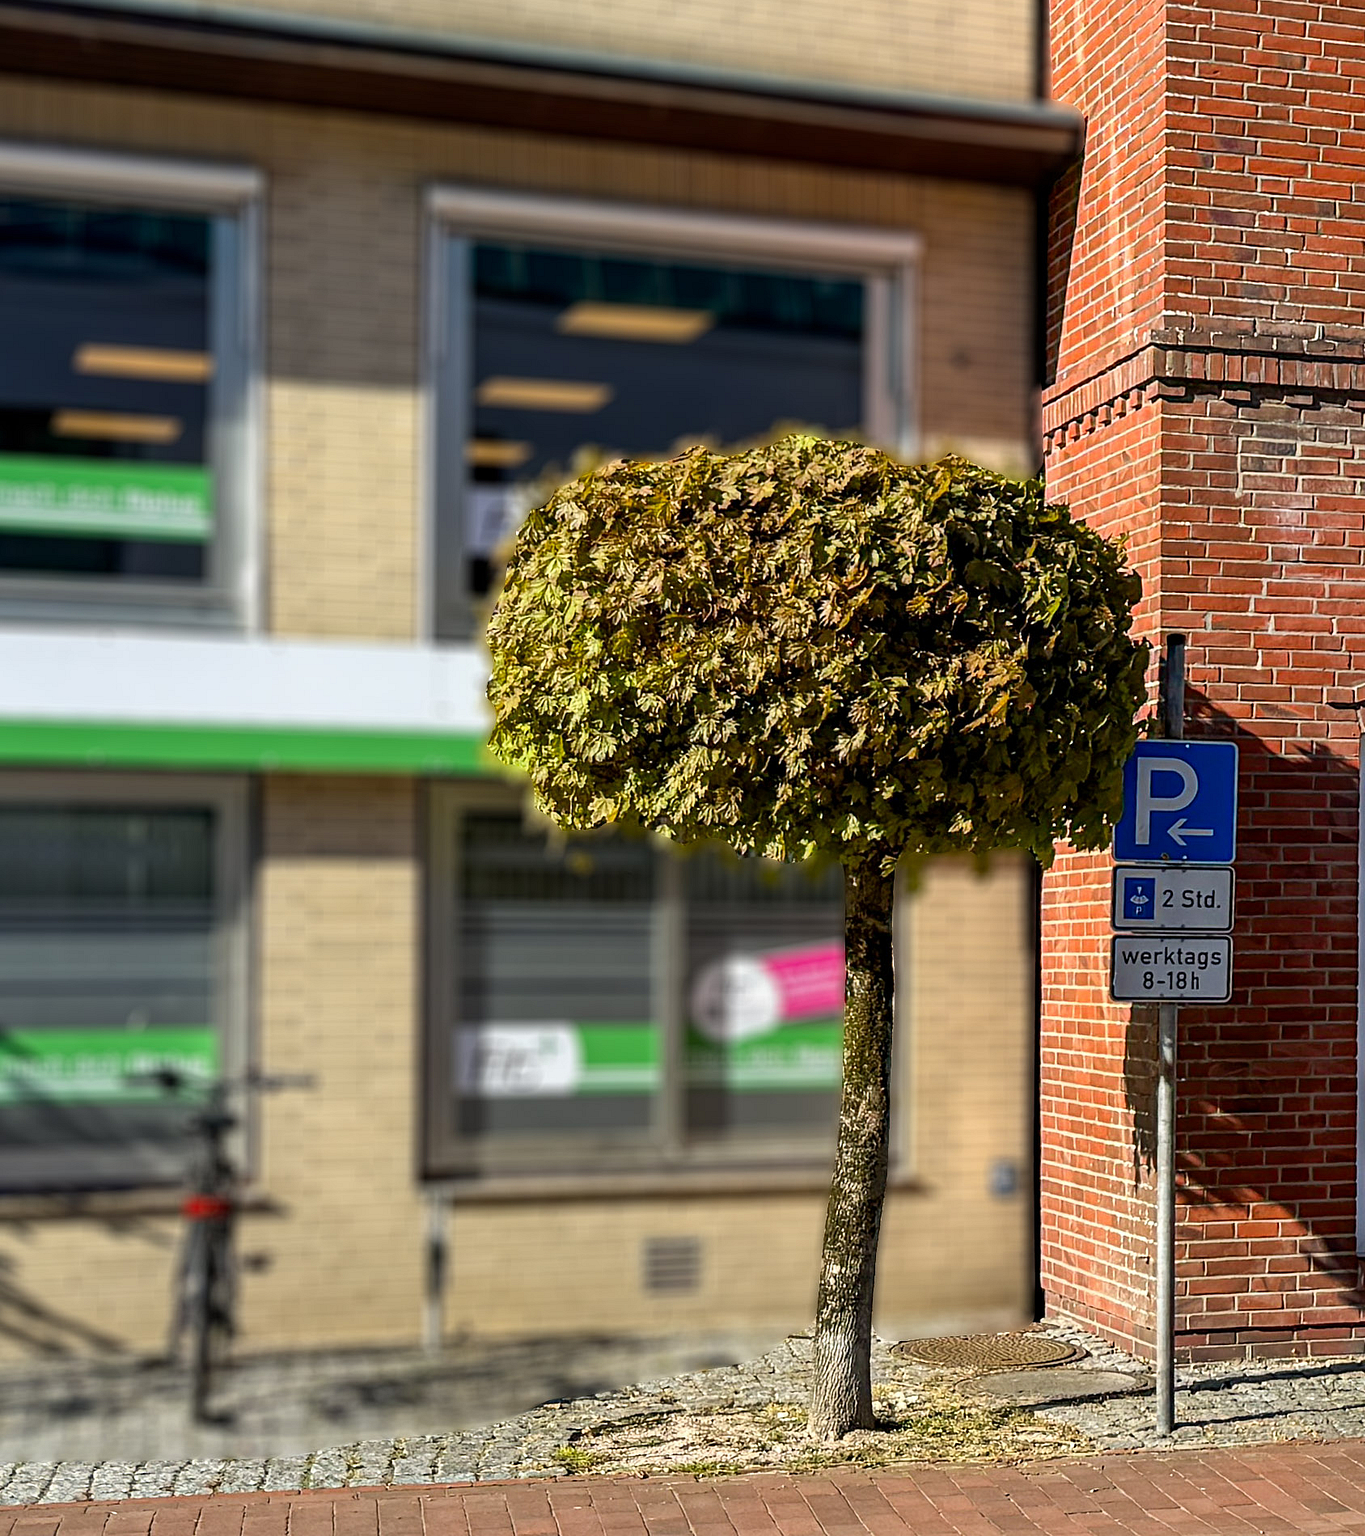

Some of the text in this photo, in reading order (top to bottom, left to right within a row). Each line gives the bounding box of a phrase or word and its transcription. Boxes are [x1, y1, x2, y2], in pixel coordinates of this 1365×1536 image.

[1135, 757, 1199, 845] P
[1162, 889, 1221, 909] 2 Std.
[1122, 947, 1222, 970] werktags
